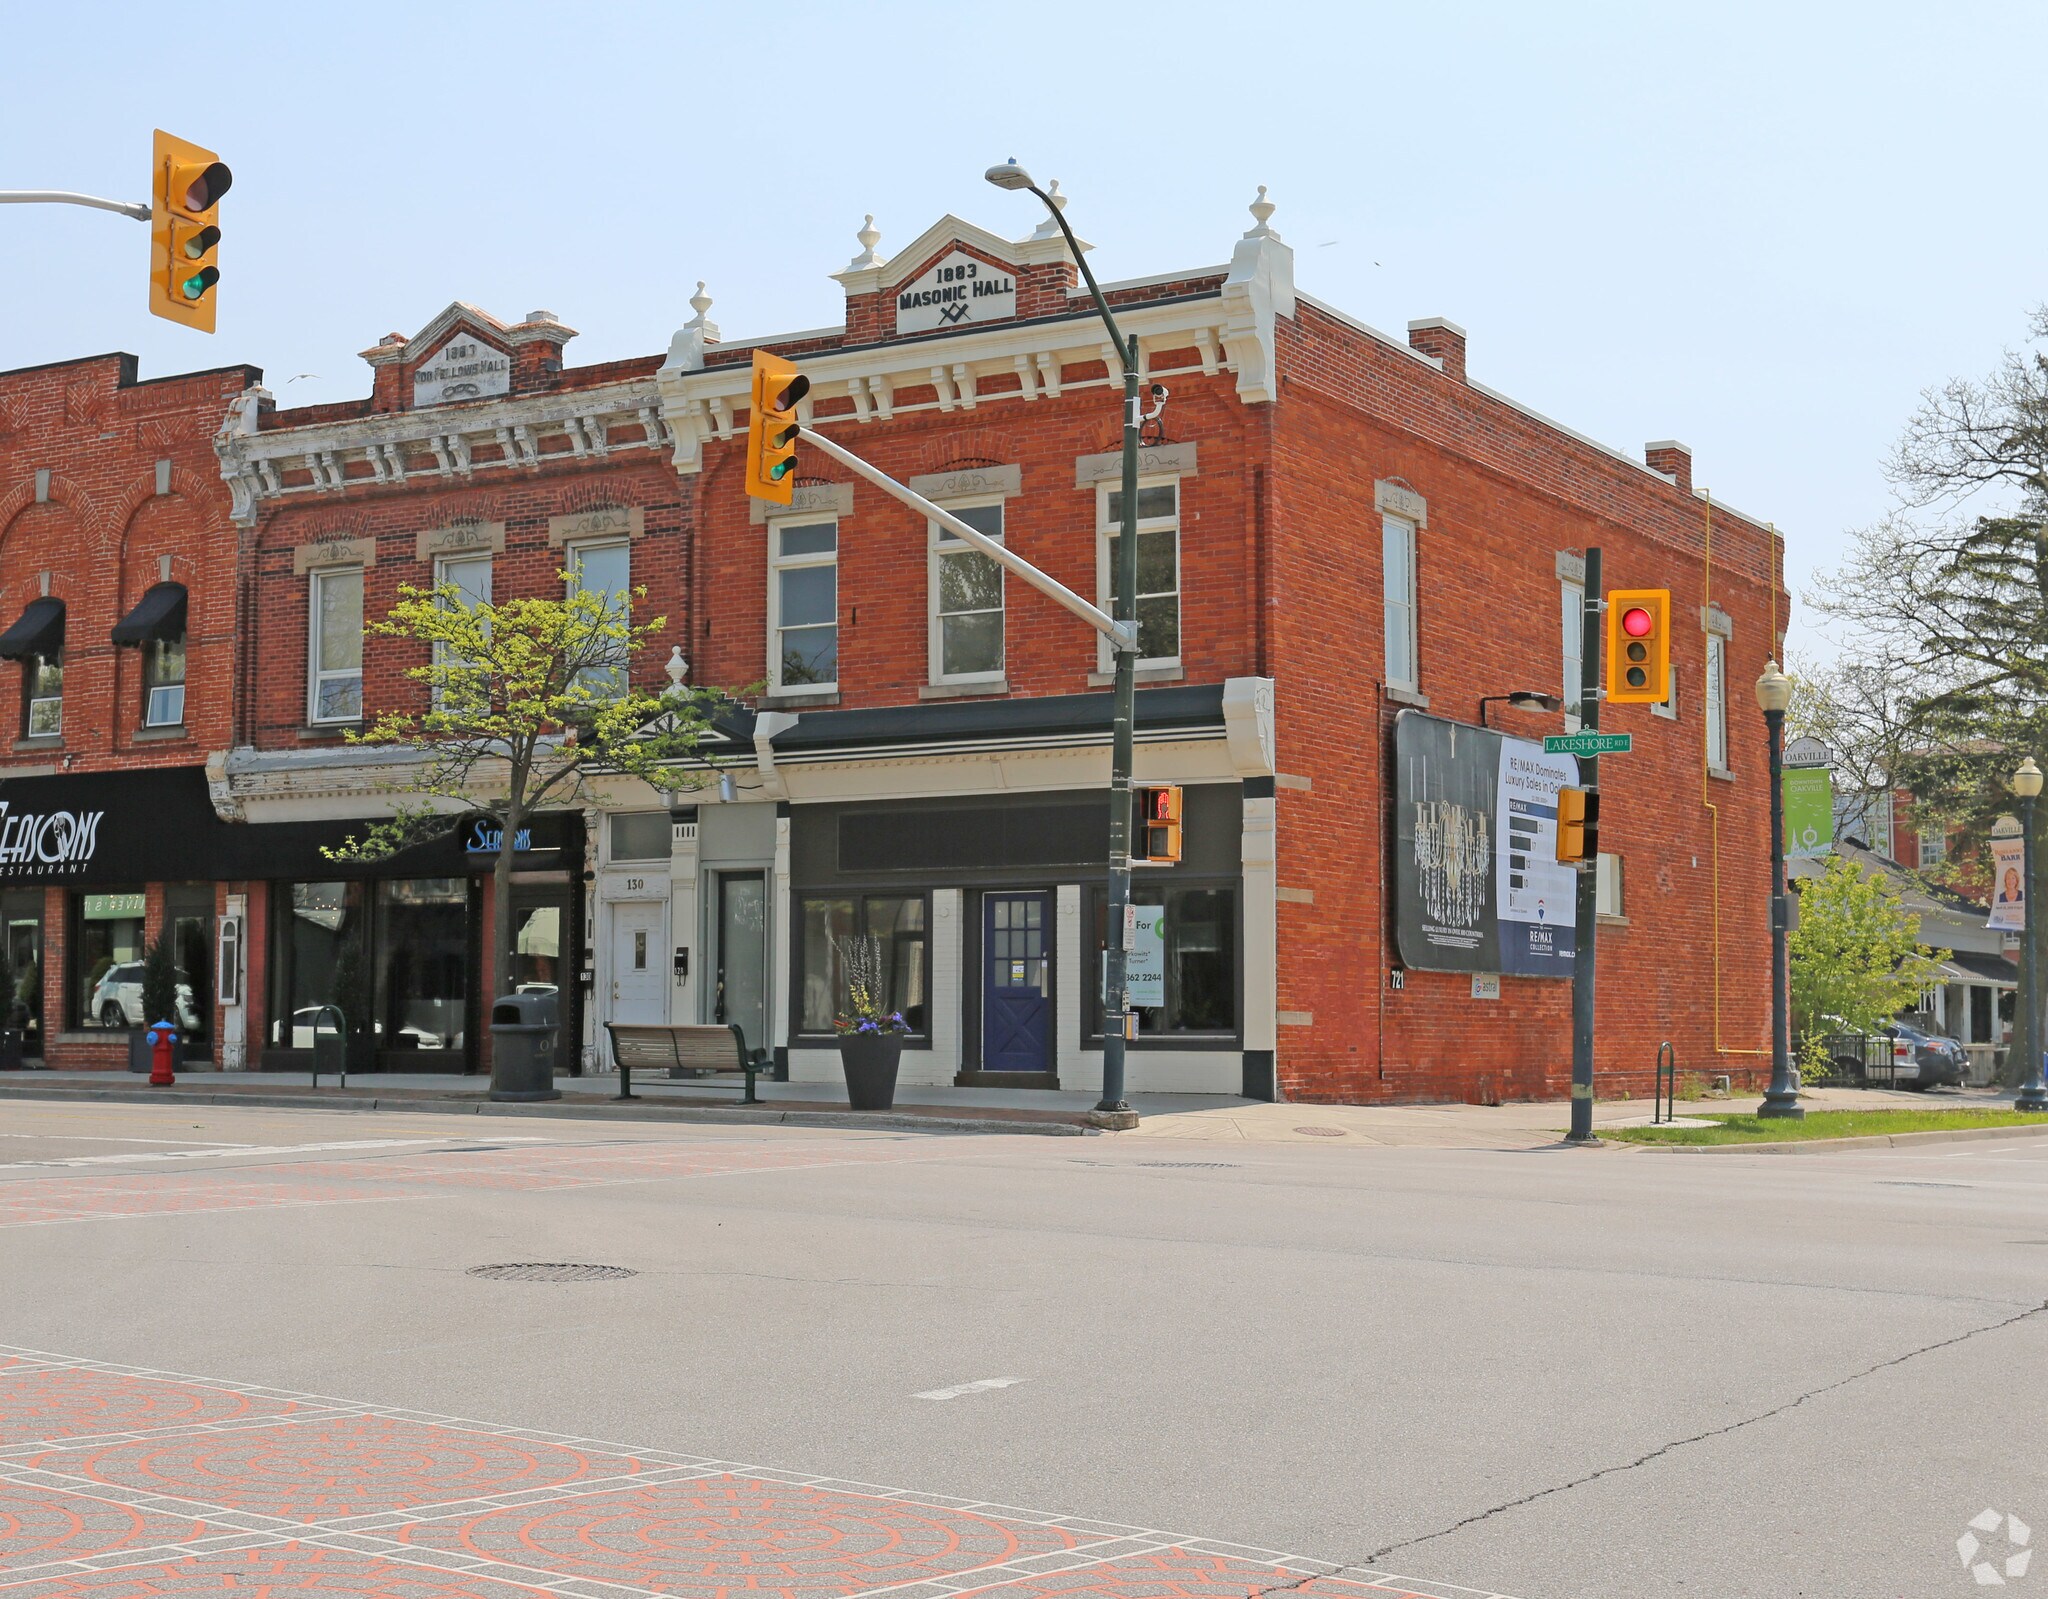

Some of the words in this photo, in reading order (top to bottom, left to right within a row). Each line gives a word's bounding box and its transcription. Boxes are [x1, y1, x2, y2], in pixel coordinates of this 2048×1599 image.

[937, 263, 977, 284] 1883
[900, 285, 967, 310] MASONIC
[973, 278, 1014, 297] HALL
[434, 361, 479, 381] FELLOWS
[480, 359, 506, 374] HALL
[1546, 737, 1613, 751] LAKESHORE
[1614, 739, 1624, 747] RD
[1785, 751, 1830, 762] OAKVILLE
[1510, 757, 1535, 773] RE/MAX
[1535, 763, 1567, 781] Dominates
[1505, 772, 1525, 790] Luxury
[1526, 776, 1542, 792] Sales
[1542, 781, 1549, 791] in
[1549, 781, 1559, 795] Oa
[1790, 785, 1824, 793] OAKVILLE
[1509, 801, 1527, 813] RE/MAX
[0, 801, 104, 863] EASONS
[1993, 826, 2021, 835] OAKVILLE
[627, 879, 644, 890] 130
[1136, 920, 1151, 930] For
[1529, 930, 1553, 944] RE/MAX
[1529, 943, 1553, 952] COLLECTION
[1558, 950, 1576, 958] remax.c
[581, 972, 592, 981] 130
[1142, 973, 1162, 982] 2244
[1391, 970, 1404, 989] 721
[1482, 981, 1498, 993] astral
